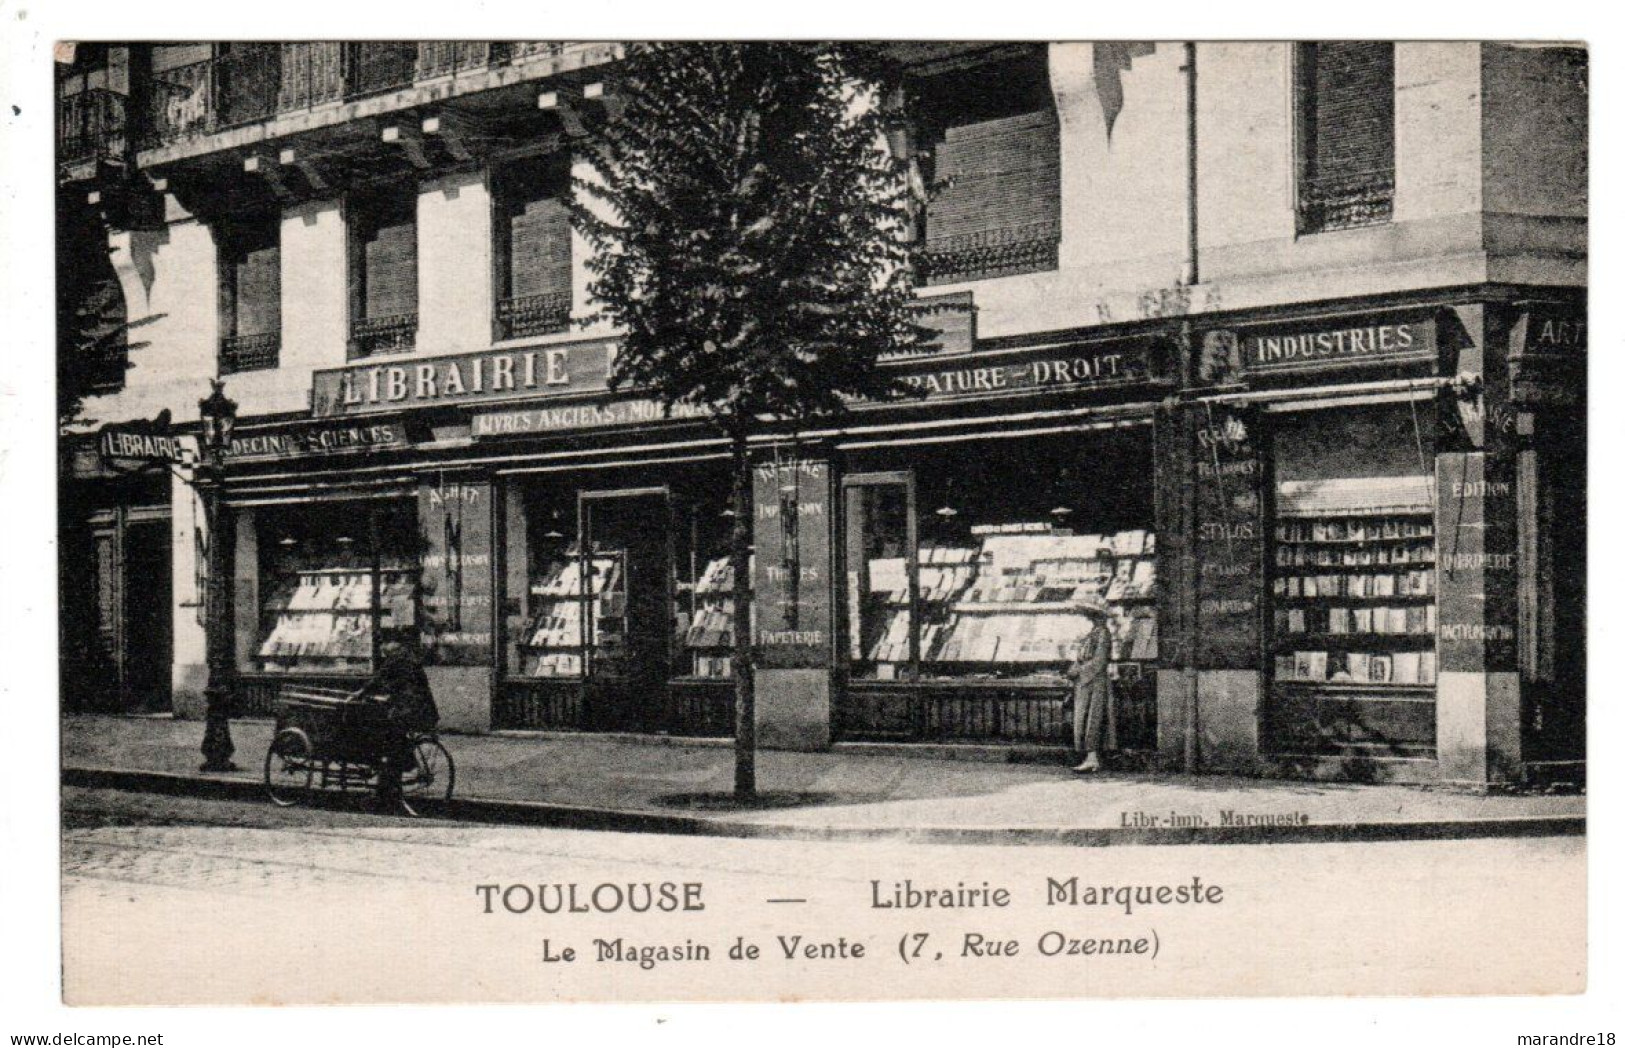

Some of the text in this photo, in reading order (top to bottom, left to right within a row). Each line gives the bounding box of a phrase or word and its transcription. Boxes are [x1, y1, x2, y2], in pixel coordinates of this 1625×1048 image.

[1257, 324, 1414, 362] INDUSTRIES
[343, 348, 571, 405] LIBRAIRIE
[1033, 354, 1121, 384] DROIT
[538, 403, 616, 429] ANCIENS
[106, 432, 184, 460] LIBRAIRIE
[308, 424, 393, 452] SCIENCES
[1451, 479, 1509, 498] EDITION
[760, 629, 822, 647] PAPETERIE
